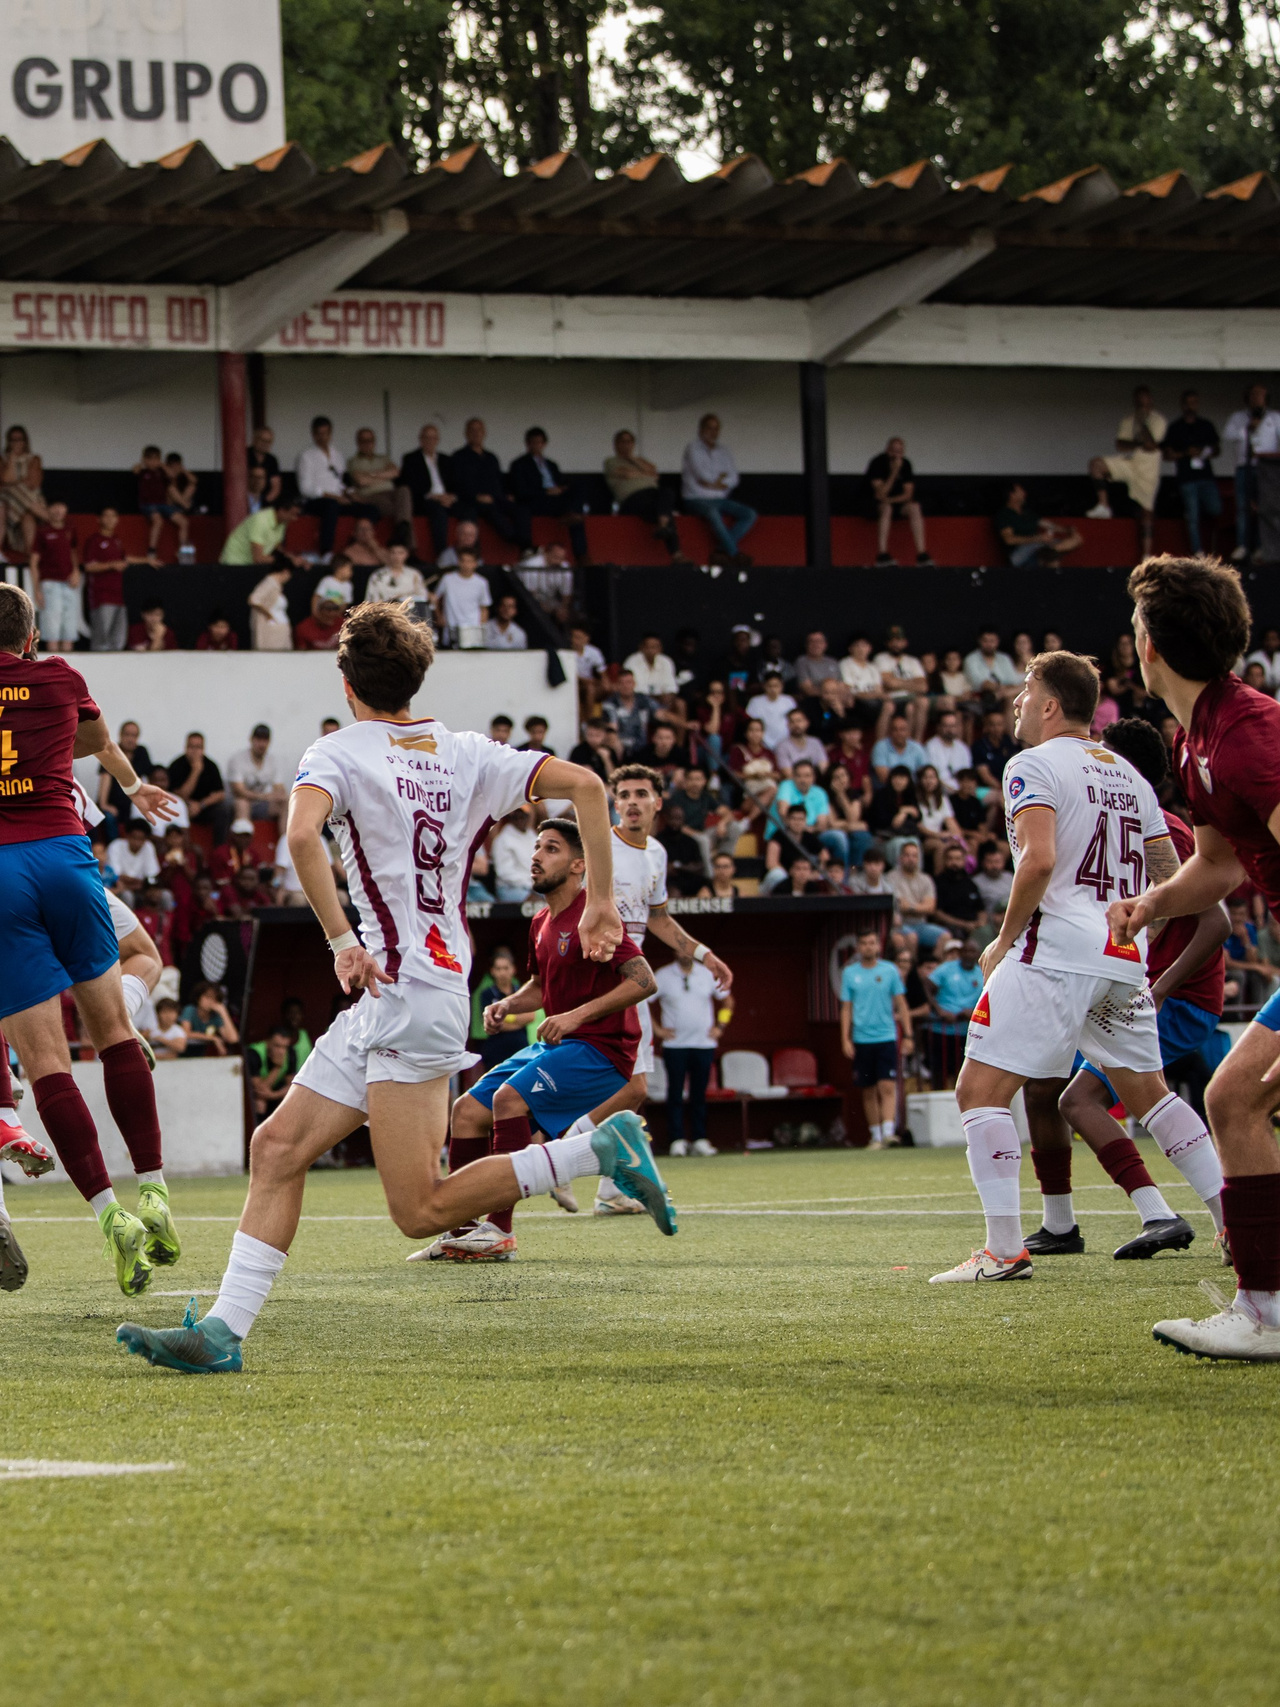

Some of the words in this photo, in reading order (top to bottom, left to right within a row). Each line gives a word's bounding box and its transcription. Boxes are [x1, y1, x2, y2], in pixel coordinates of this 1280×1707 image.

[12, 56, 269, 124] GRUPO
[1074, 810, 1144, 903] 45
[1173, 1131, 1208, 1156] PLAYO
